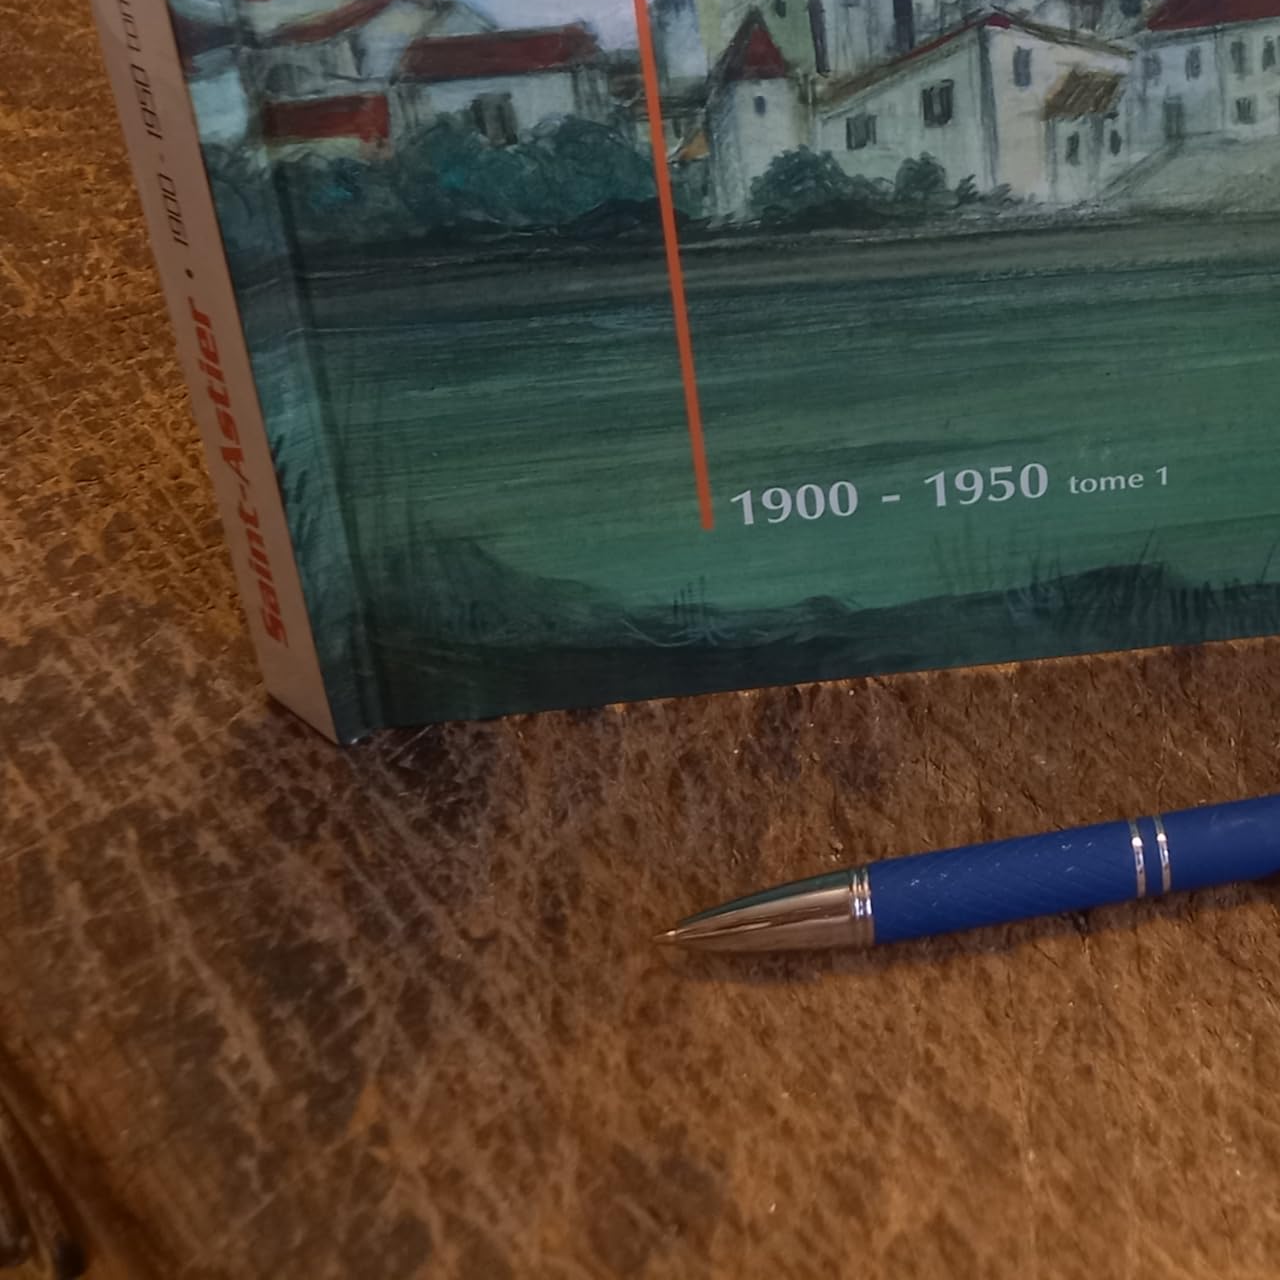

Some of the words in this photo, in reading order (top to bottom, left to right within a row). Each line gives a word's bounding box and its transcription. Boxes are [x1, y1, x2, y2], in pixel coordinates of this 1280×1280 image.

[188, 296, 289, 649] Saint-Astier
[730, 480, 859, 526] 1900
[923, 463, 1049, 507] 1950
[1069, 472, 1144, 494] tome
[1156, 466, 1169, 486] 1
